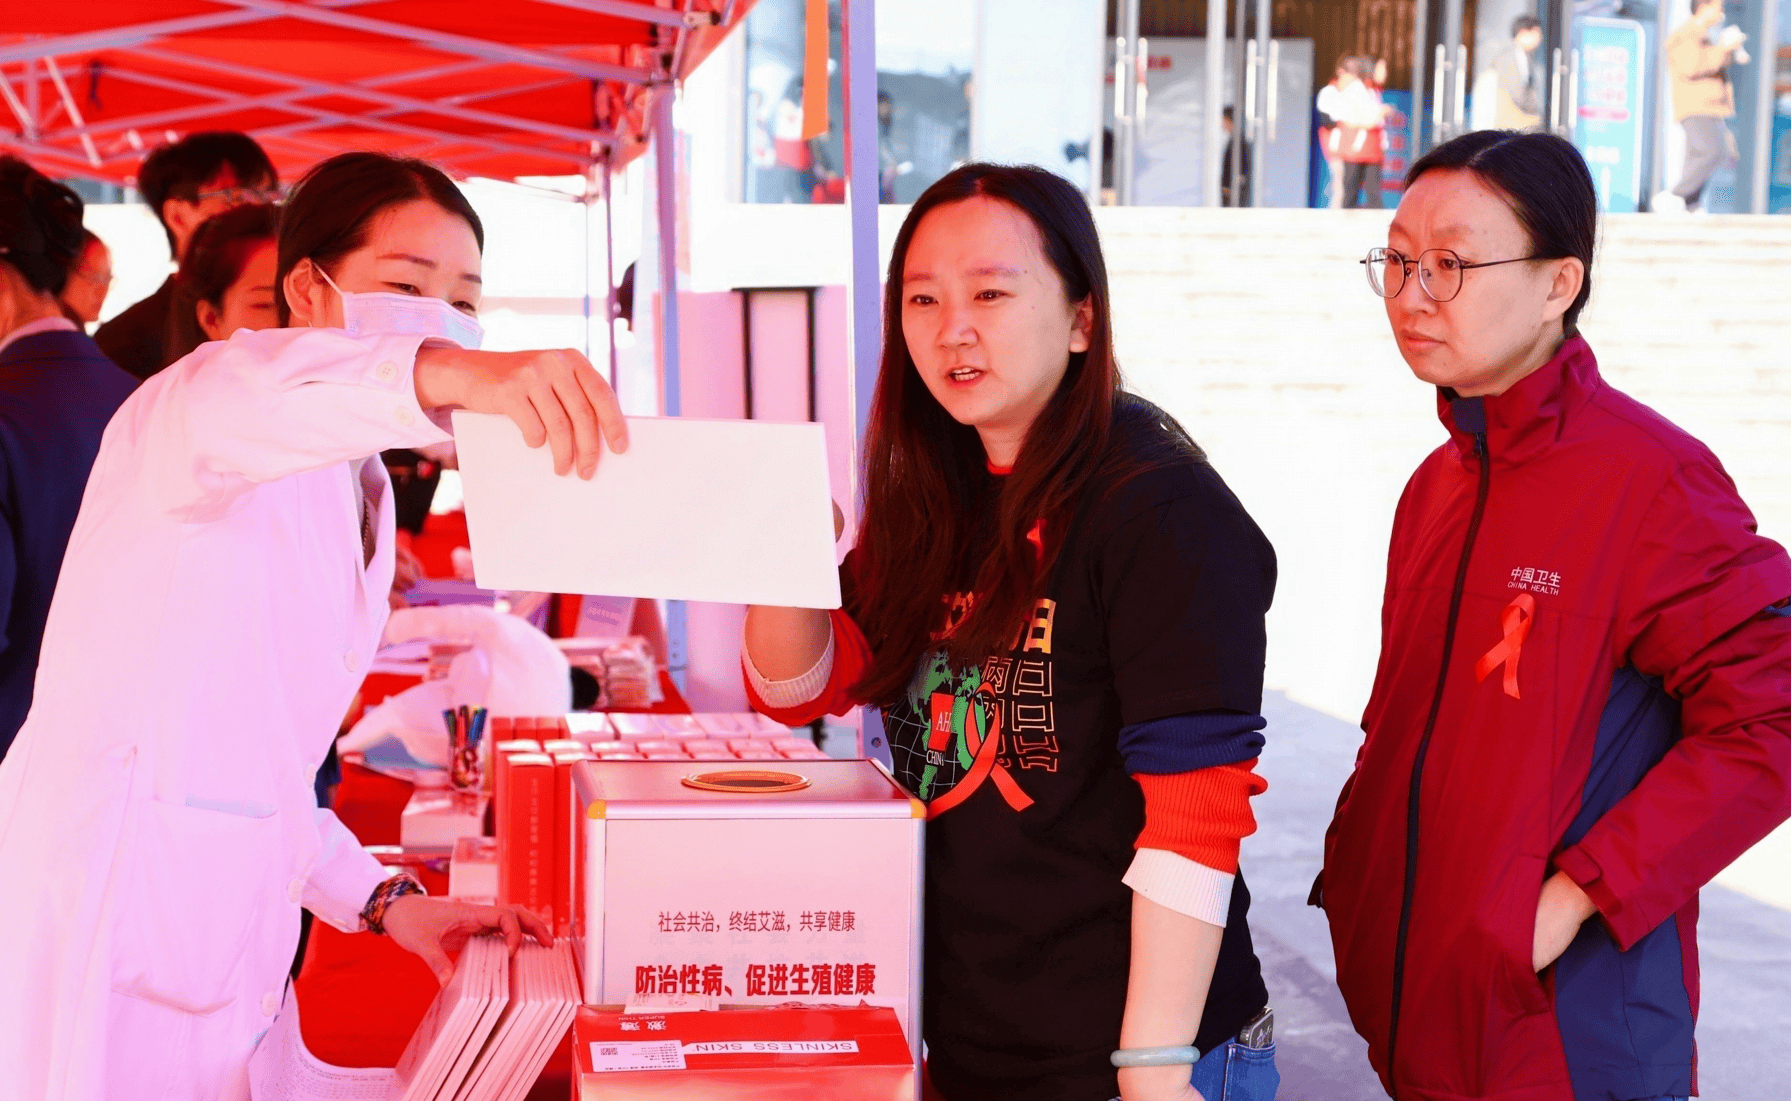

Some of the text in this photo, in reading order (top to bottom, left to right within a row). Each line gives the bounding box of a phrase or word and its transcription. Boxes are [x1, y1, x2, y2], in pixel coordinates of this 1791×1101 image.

[1511, 566, 1561, 588] 中国卫生
[1507, 581, 1560, 596] CHINA HEALTH
[935, 711, 952, 733] AH
[658, 911, 856, 932] 社会共治，终结艾滋，共享健康
[635, 963, 876, 997] 防治性病、促进生殖健康
[696, 1042, 853, 1052] SKINLESS SKIN
